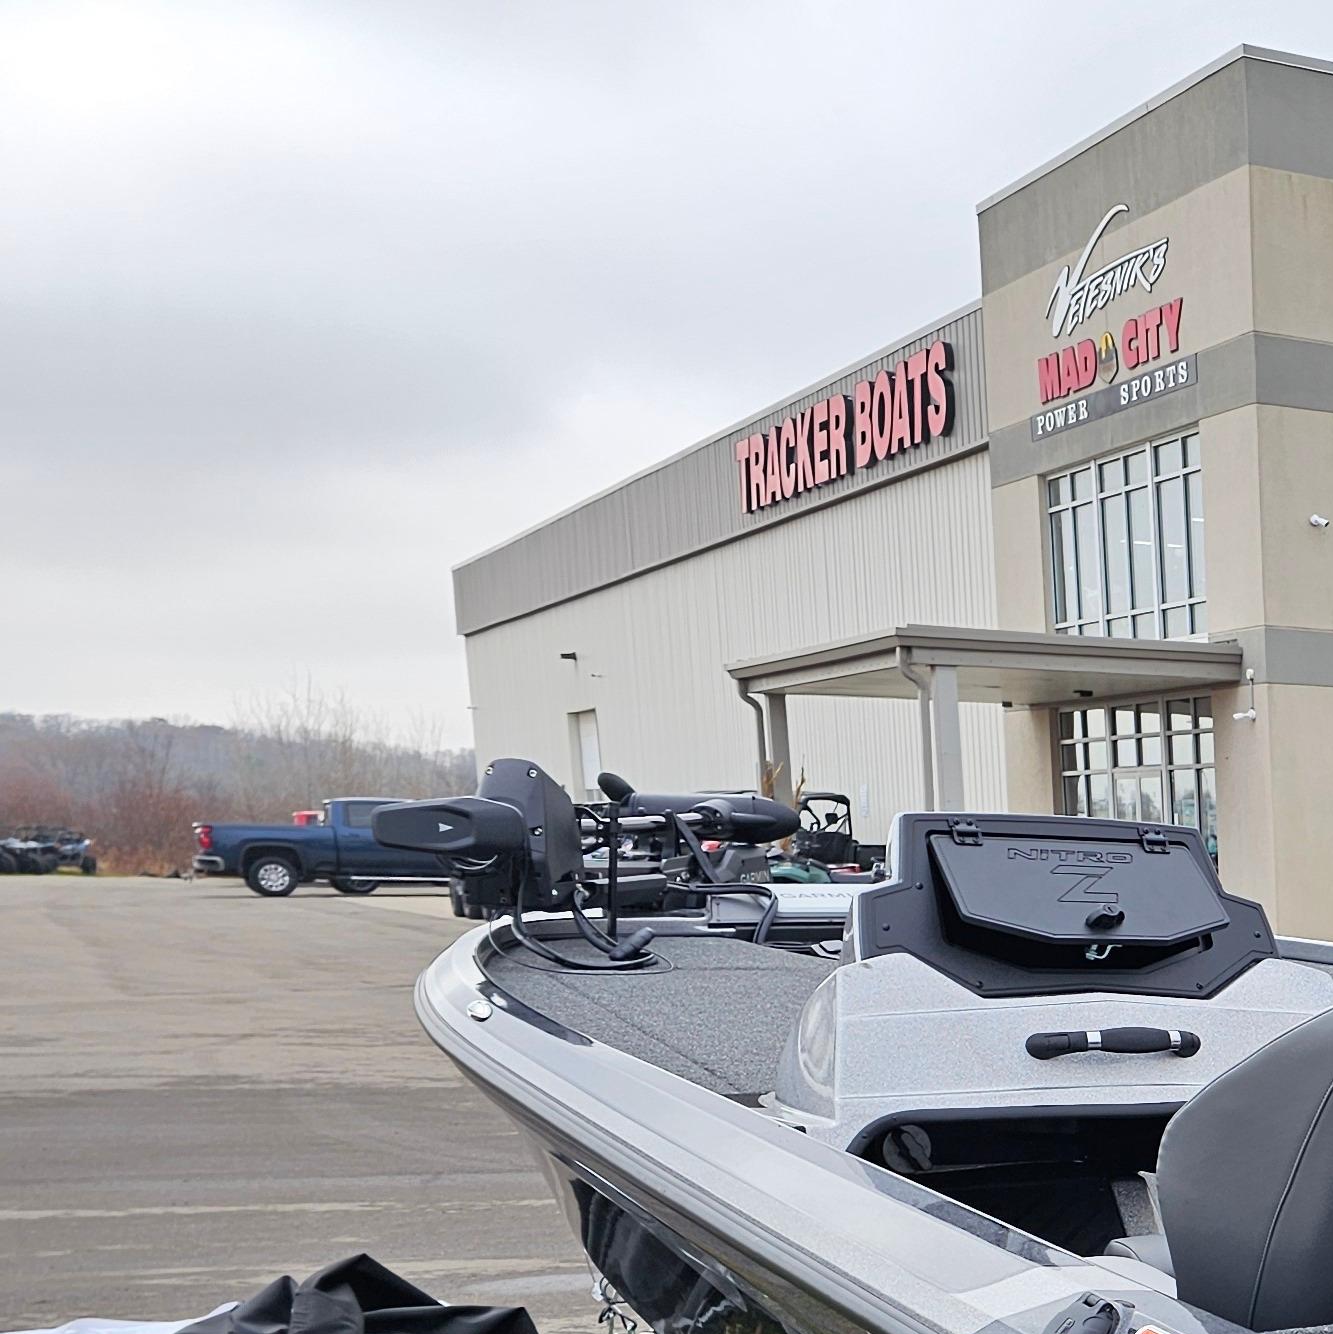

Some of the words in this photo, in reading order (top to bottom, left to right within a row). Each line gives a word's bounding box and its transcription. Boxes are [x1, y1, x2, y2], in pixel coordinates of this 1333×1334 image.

[1045, 203, 1169, 338] VETESNIK'S
[1037, 338, 1097, 406] MAD
[1121, 297, 1184, 370] CITY
[736, 394, 848, 514] TRACKER
[855, 340, 948, 468] BOATS
[1036, 400, 1088, 435] POWER
[1120, 362, 1188, 405] SPORTS
[1007, 848, 1133, 864] NITRO
[1050, 864, 1119, 903] Z
